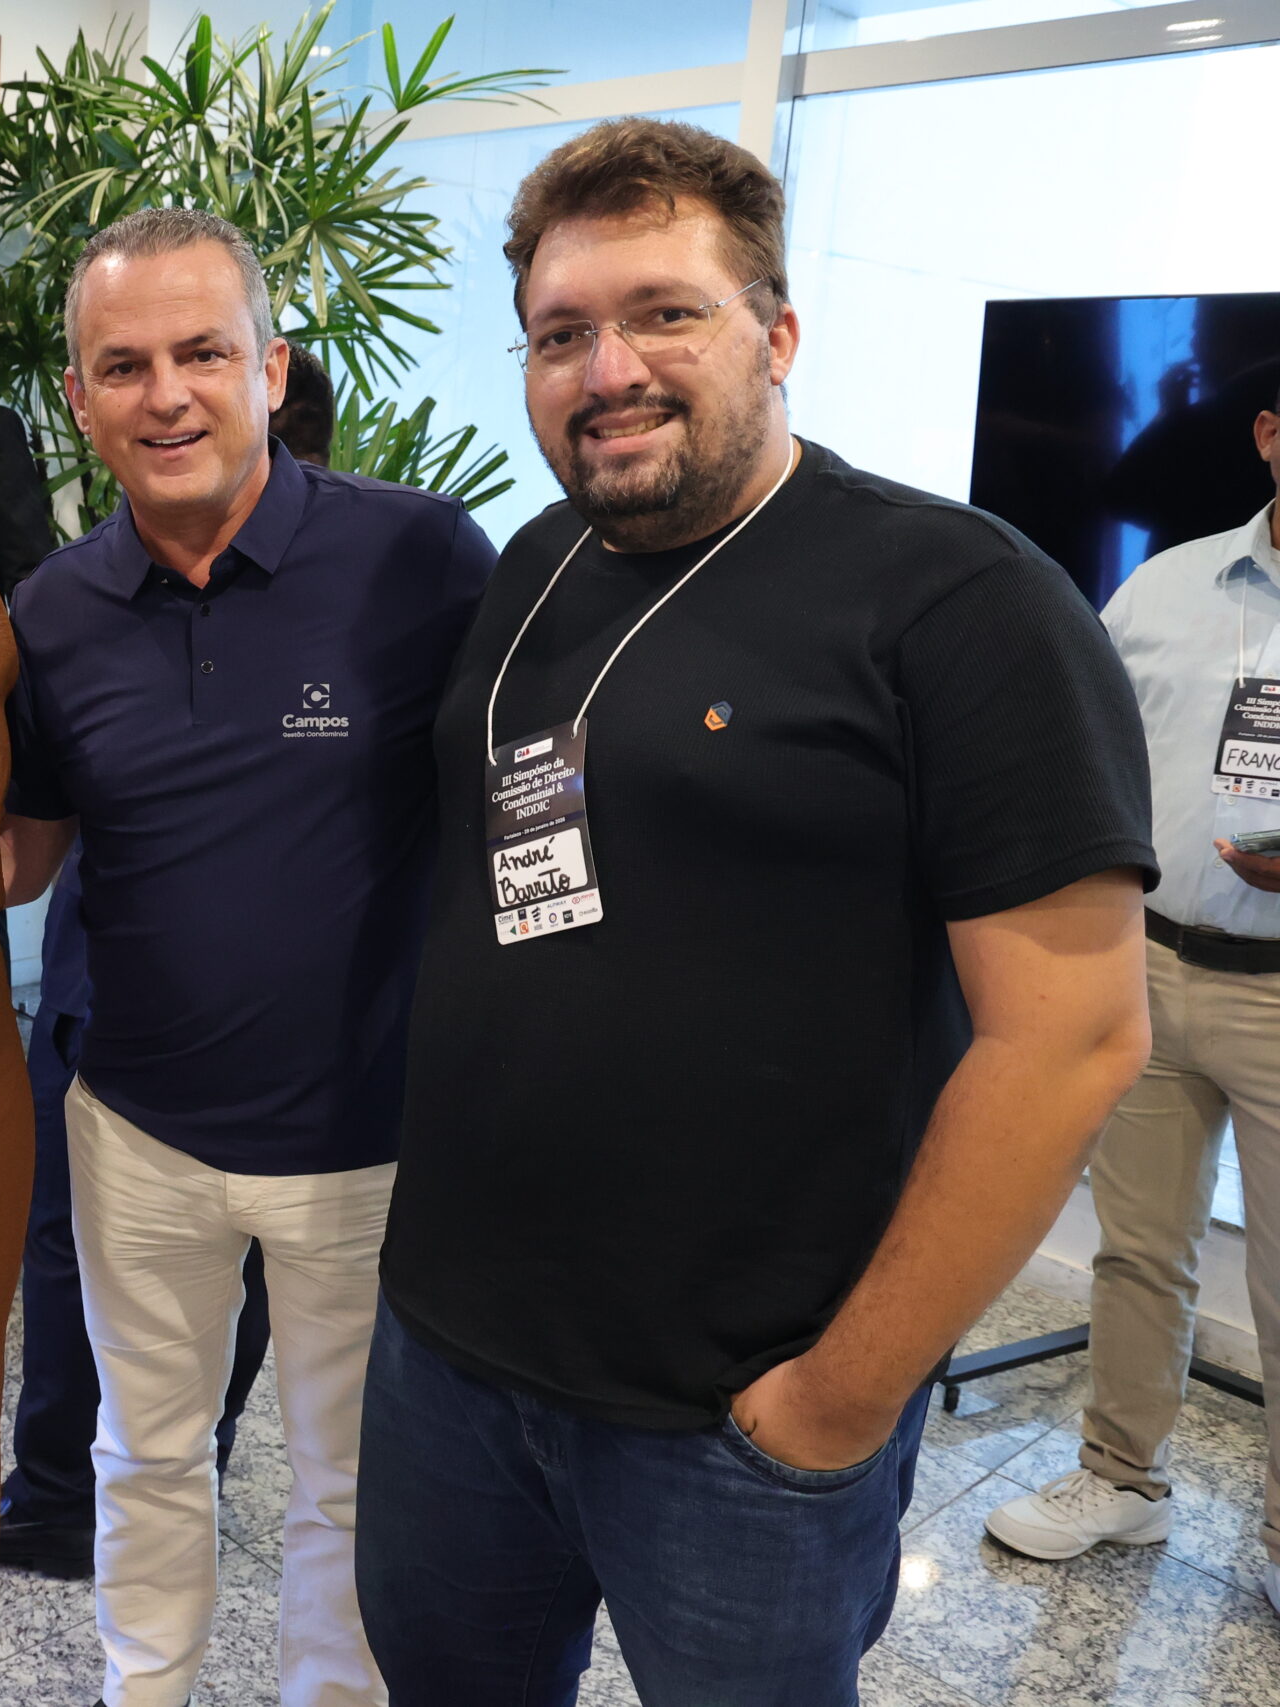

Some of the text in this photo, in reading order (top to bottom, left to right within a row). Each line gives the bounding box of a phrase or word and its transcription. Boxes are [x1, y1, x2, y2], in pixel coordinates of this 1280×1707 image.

[282, 713, 350, 731] Campos
[491, 767, 576, 803] Comissão de Direito
[501, 757, 565, 787] III Simpósio da
[502, 781, 565, 812] Condominial &
[516, 799, 551, 820] INDDIC
[498, 835, 555, 872] André
